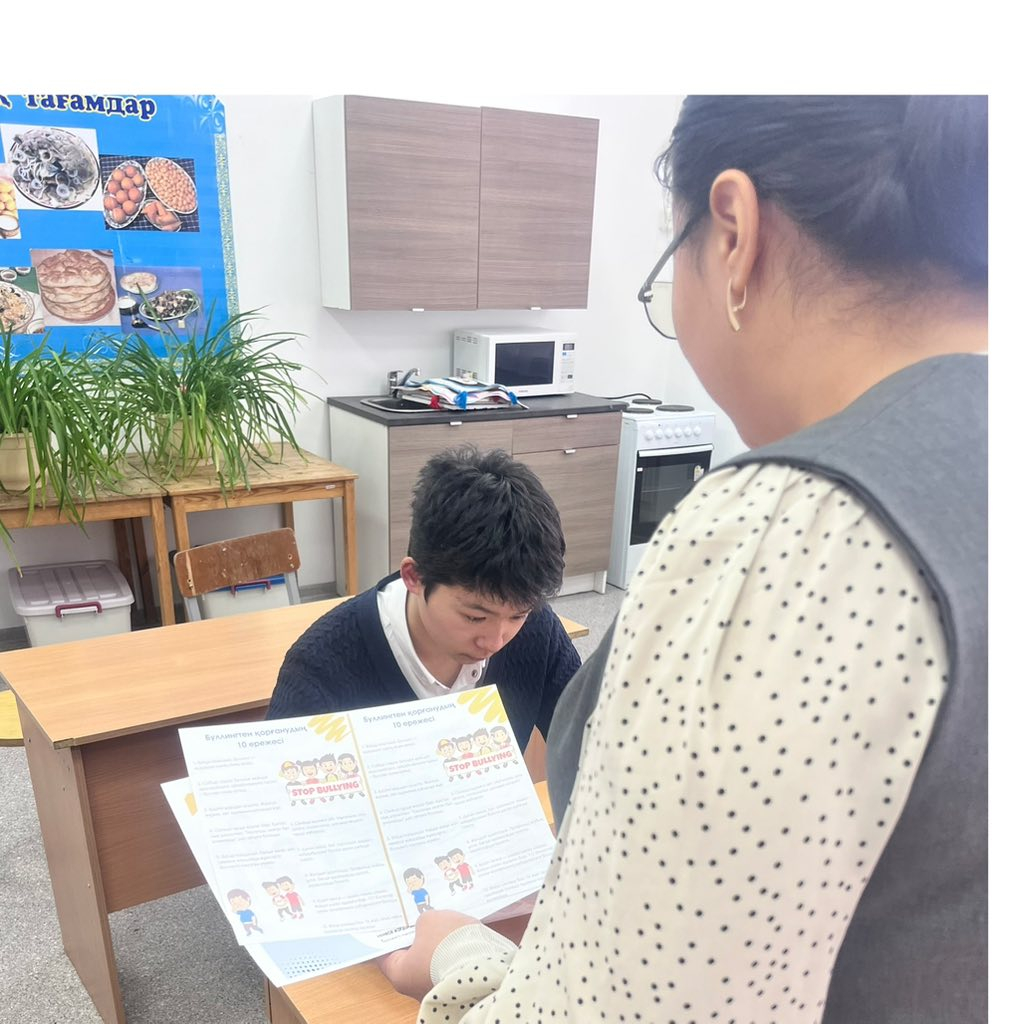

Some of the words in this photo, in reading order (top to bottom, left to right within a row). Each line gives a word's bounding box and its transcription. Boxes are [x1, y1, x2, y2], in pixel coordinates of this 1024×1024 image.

[448, 761, 471, 773] STOP
[472, 750, 513, 767] BULLYING
[291, 786, 316, 797] STOP
[316, 780, 360, 795] BULLYING
